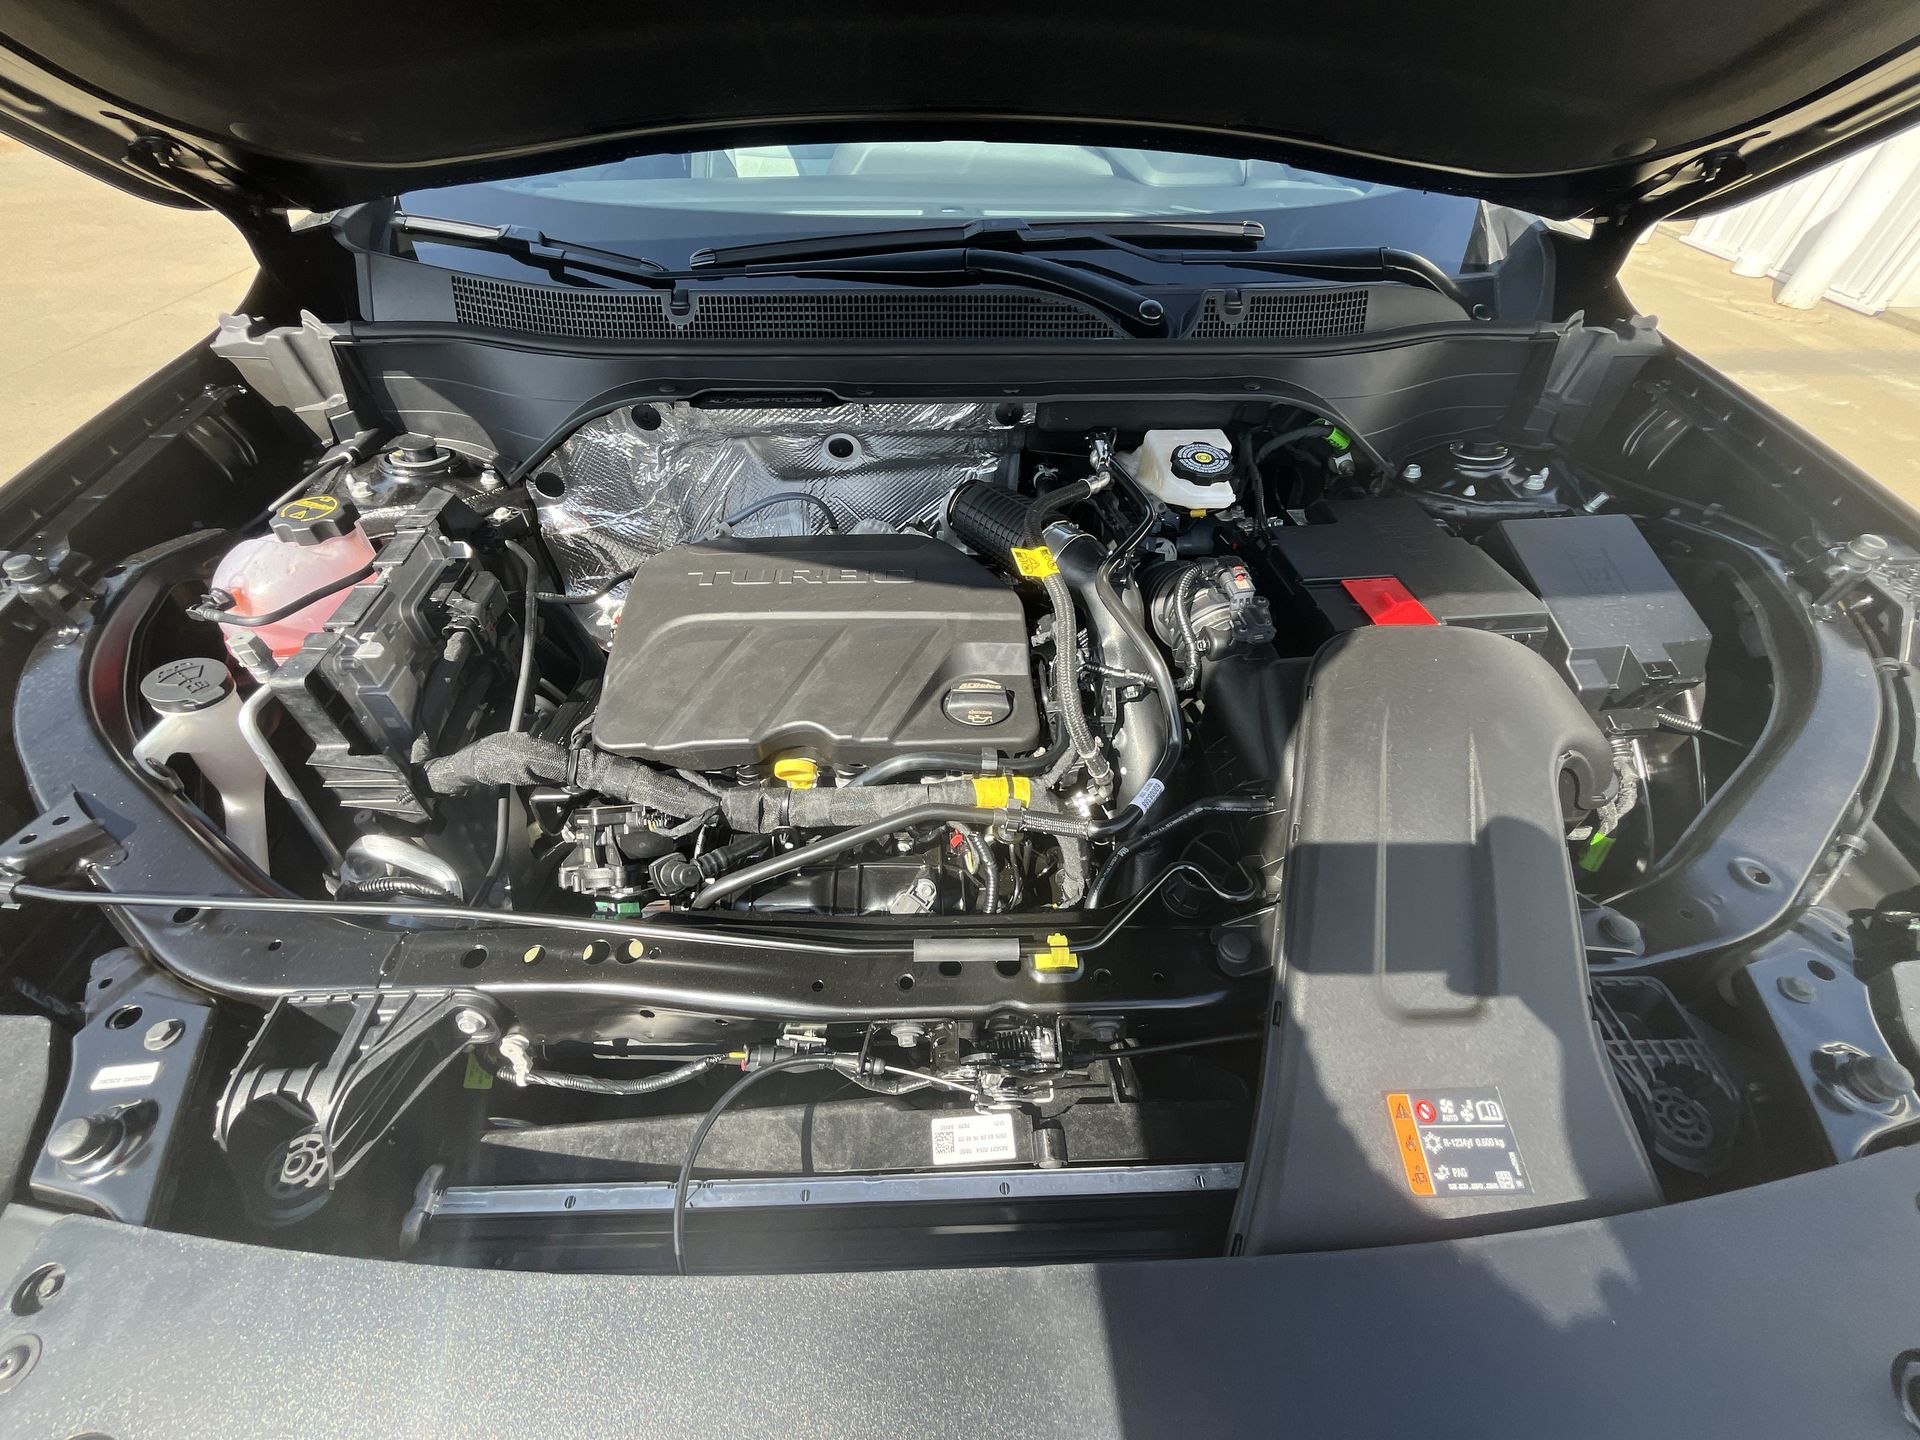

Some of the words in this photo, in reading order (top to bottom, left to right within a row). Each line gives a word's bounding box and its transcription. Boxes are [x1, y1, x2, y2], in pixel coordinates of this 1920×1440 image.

[688, 568, 918, 586] TURBO
[1442, 1114, 1459, 1122] AUTO
[1452, 1167, 1468, 1178] PAG
